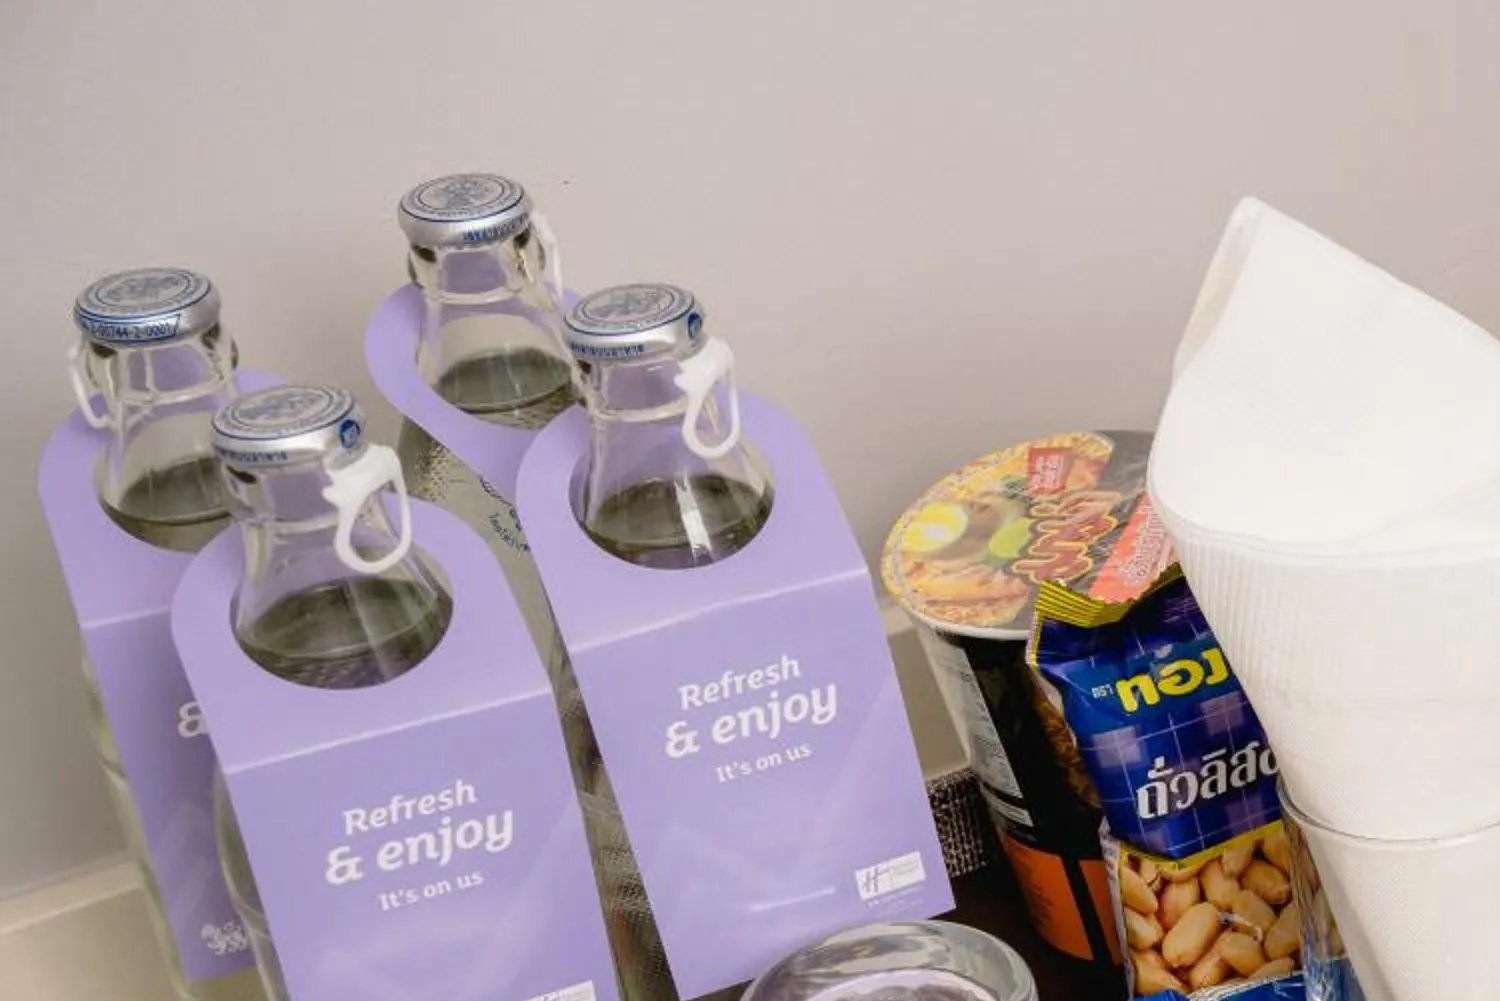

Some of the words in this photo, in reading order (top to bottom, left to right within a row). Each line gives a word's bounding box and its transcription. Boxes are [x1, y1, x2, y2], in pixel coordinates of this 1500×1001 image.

[678, 654, 801, 711] Refresh
[665, 720, 701, 759] &
[711, 684, 838, 745] enjoy
[716, 756, 752, 784] It's
[756, 751, 783, 772] on
[787, 743, 812, 762] us
[343, 779, 478, 836] Refresh
[325, 845, 363, 885] &
[376, 809, 514, 873] enjoy
[378, 884, 420, 912] It's
[423, 878, 453, 900] on
[457, 869, 487, 891] us
